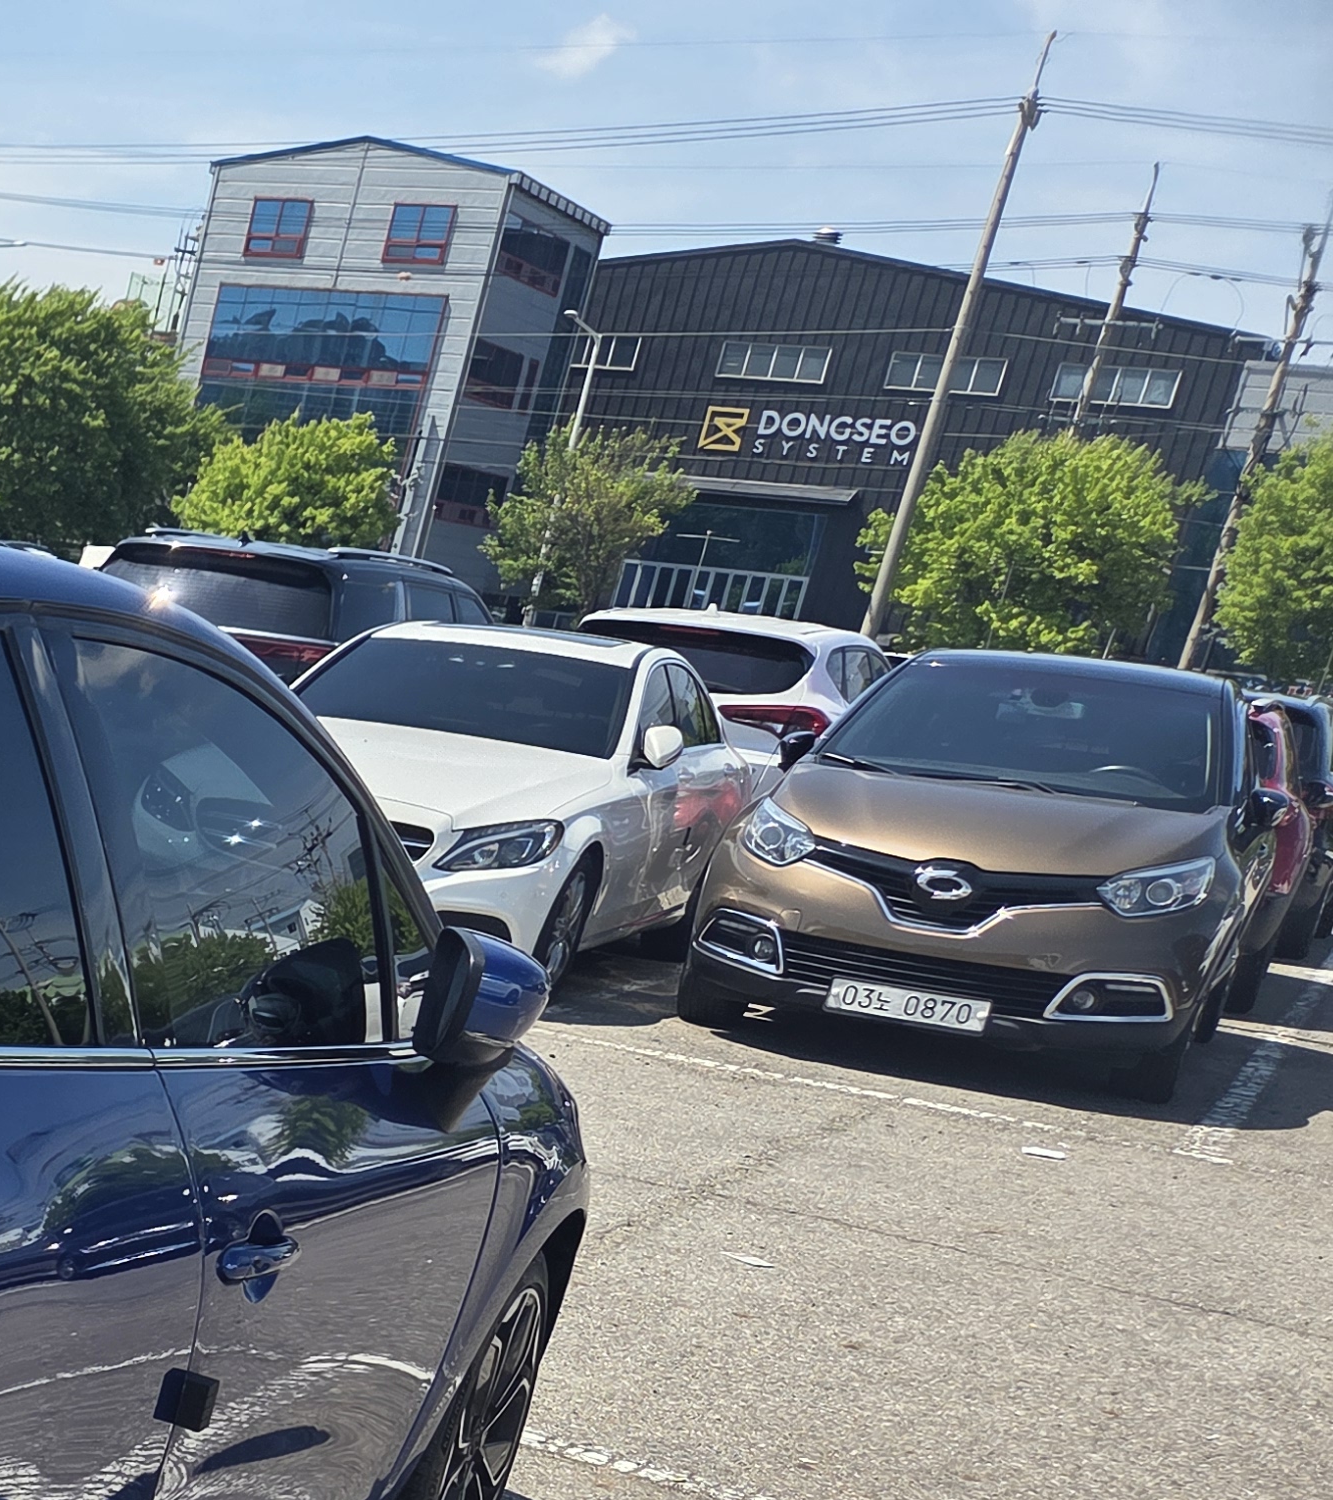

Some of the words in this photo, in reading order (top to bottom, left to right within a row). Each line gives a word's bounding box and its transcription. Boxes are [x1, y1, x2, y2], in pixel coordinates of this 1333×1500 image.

[758, 410, 916, 446] DONGSEO
[753, 439, 910, 465] SYSTEM
[841, 984, 893, 1012] 03노
[903, 994, 973, 1025] 0870
